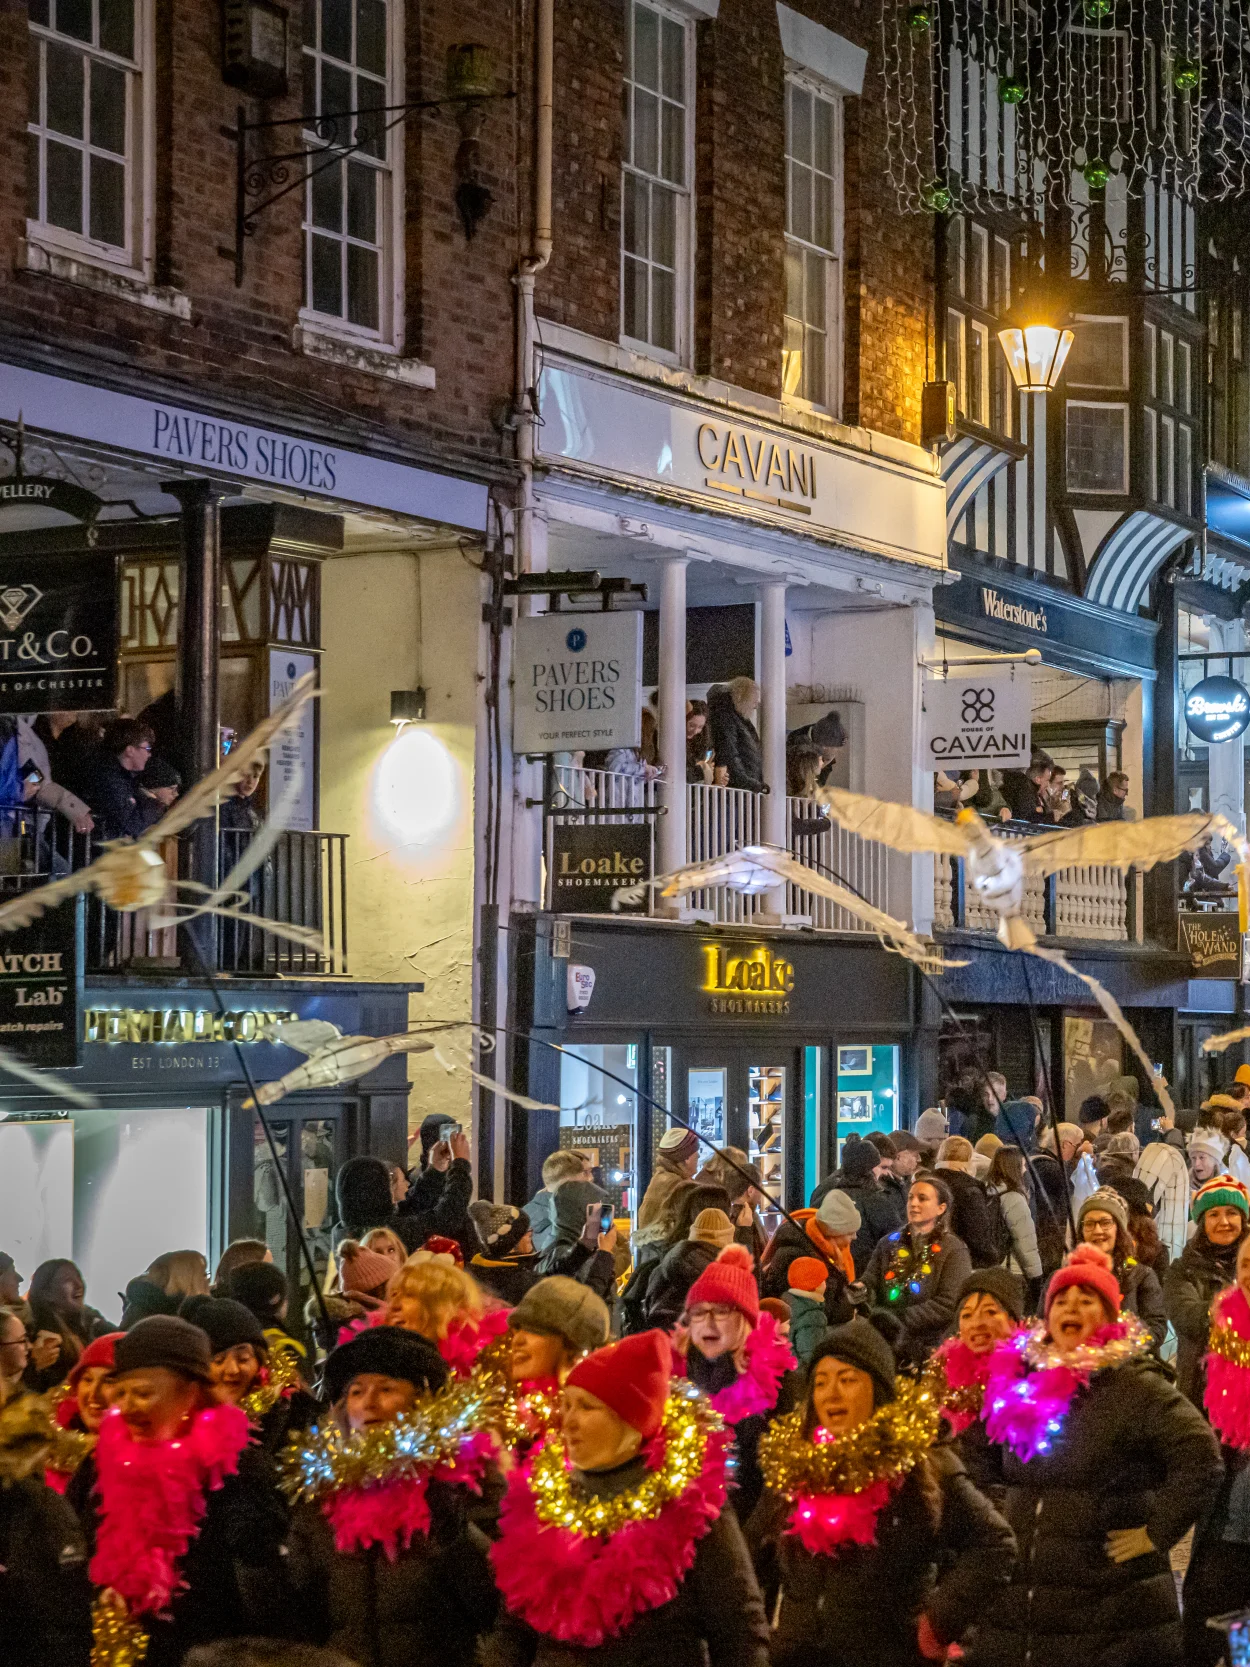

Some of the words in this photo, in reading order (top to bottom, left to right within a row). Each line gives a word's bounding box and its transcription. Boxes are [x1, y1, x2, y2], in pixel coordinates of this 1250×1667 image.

[153, 409, 249, 470] PAVERS
[255, 435, 337, 491] SHOES
[697, 422, 817, 499] CAVANI
[0, 484, 55, 498] ELLERY
[982, 587, 1048, 632] Waterstone's
[532, 659, 620, 687] PAVERS
[15, 681, 32, 690] OF
[37, 679, 104, 690] CHESTER
[535, 686, 616, 713] SHOES
[539, 732, 559, 740] YOUR
[561, 730, 590, 739] PERFECT
[593, 728, 614, 737] STYLE
[930, 733, 1026, 754] CAVANI
[559, 852, 645, 875] Loake
[558, 877, 645, 887] SHOEMAKERS
[1187, 923, 1202, 934] THE
[1189, 930, 1217, 945] HOLE
[1199, 941, 1237, 955] WAND
[702, 945, 795, 992] Loake
[15, 986, 63, 1006] Lab
[710, 998, 790, 1013] SHOEMAKERS
[25, 1021, 64, 1033] repairs
[159, 1057, 204, 1069] LONDON
[572, 1134, 618, 1145] SHOEMAKERS
